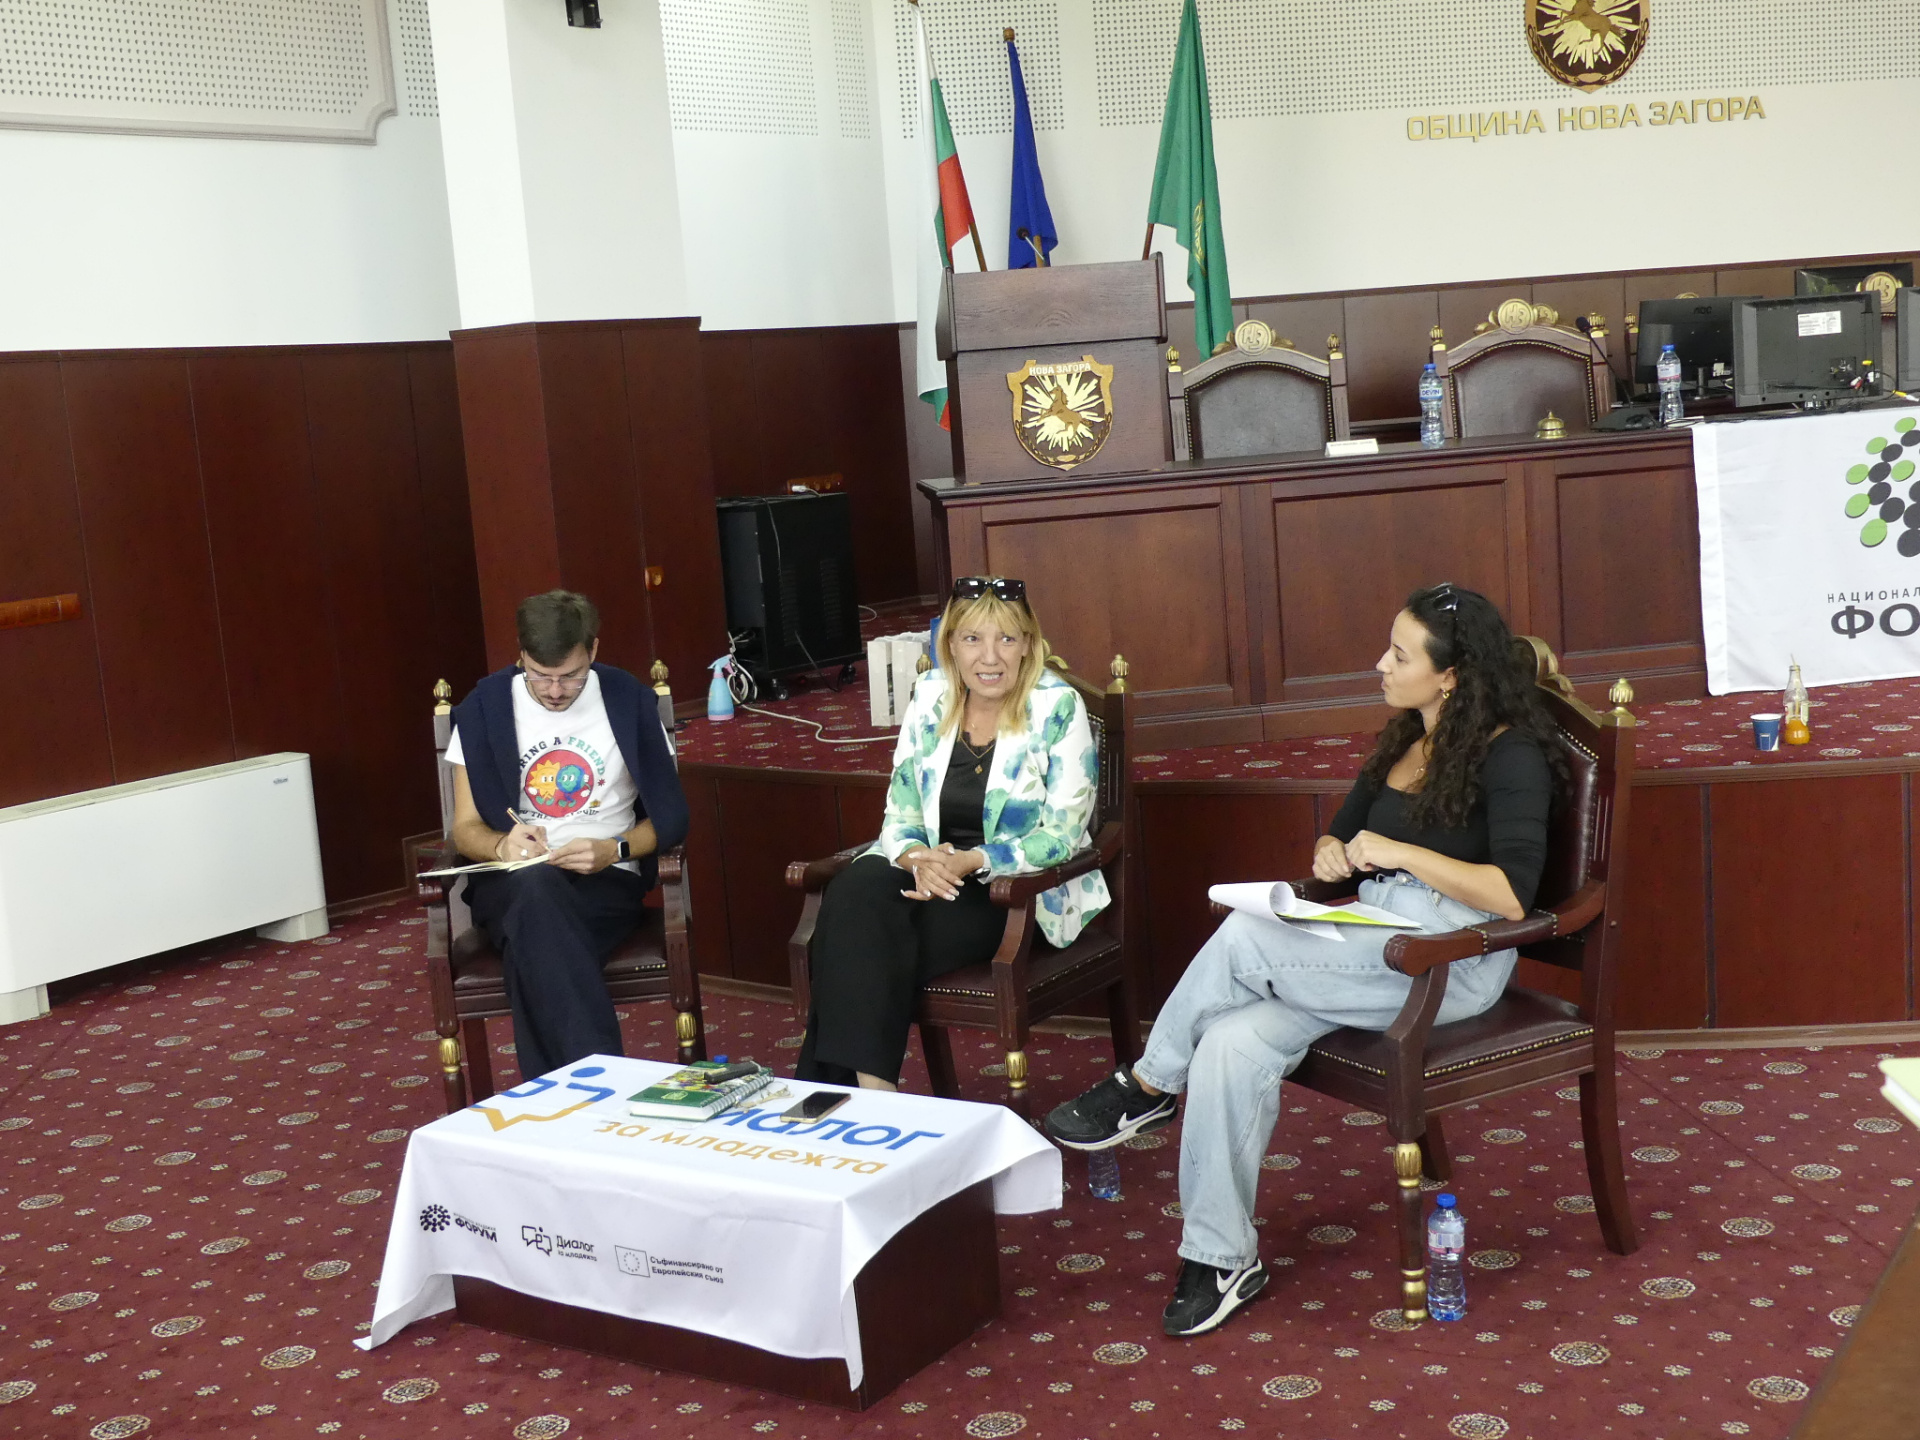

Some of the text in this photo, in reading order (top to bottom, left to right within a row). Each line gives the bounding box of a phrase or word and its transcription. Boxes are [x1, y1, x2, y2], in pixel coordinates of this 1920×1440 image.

[1406, 95, 1766, 142] ОБЩИНА НОВА ЗАГОРА
[1029, 362, 1091, 375] НОВА ЗАГОРА
[1830, 603, 1920, 639] ФО
[519, 736, 606, 776] RING A FRIEND
[714, 1107, 946, 1151] иалог
[593, 1120, 889, 1175] за младежта
[455, 1217, 498, 1243] ФОРУМ
[556, 1234, 595, 1252] Диалог
[650, 1256, 723, 1274] Съфинансирано от
[652, 1266, 724, 1284] Европейския съюз
